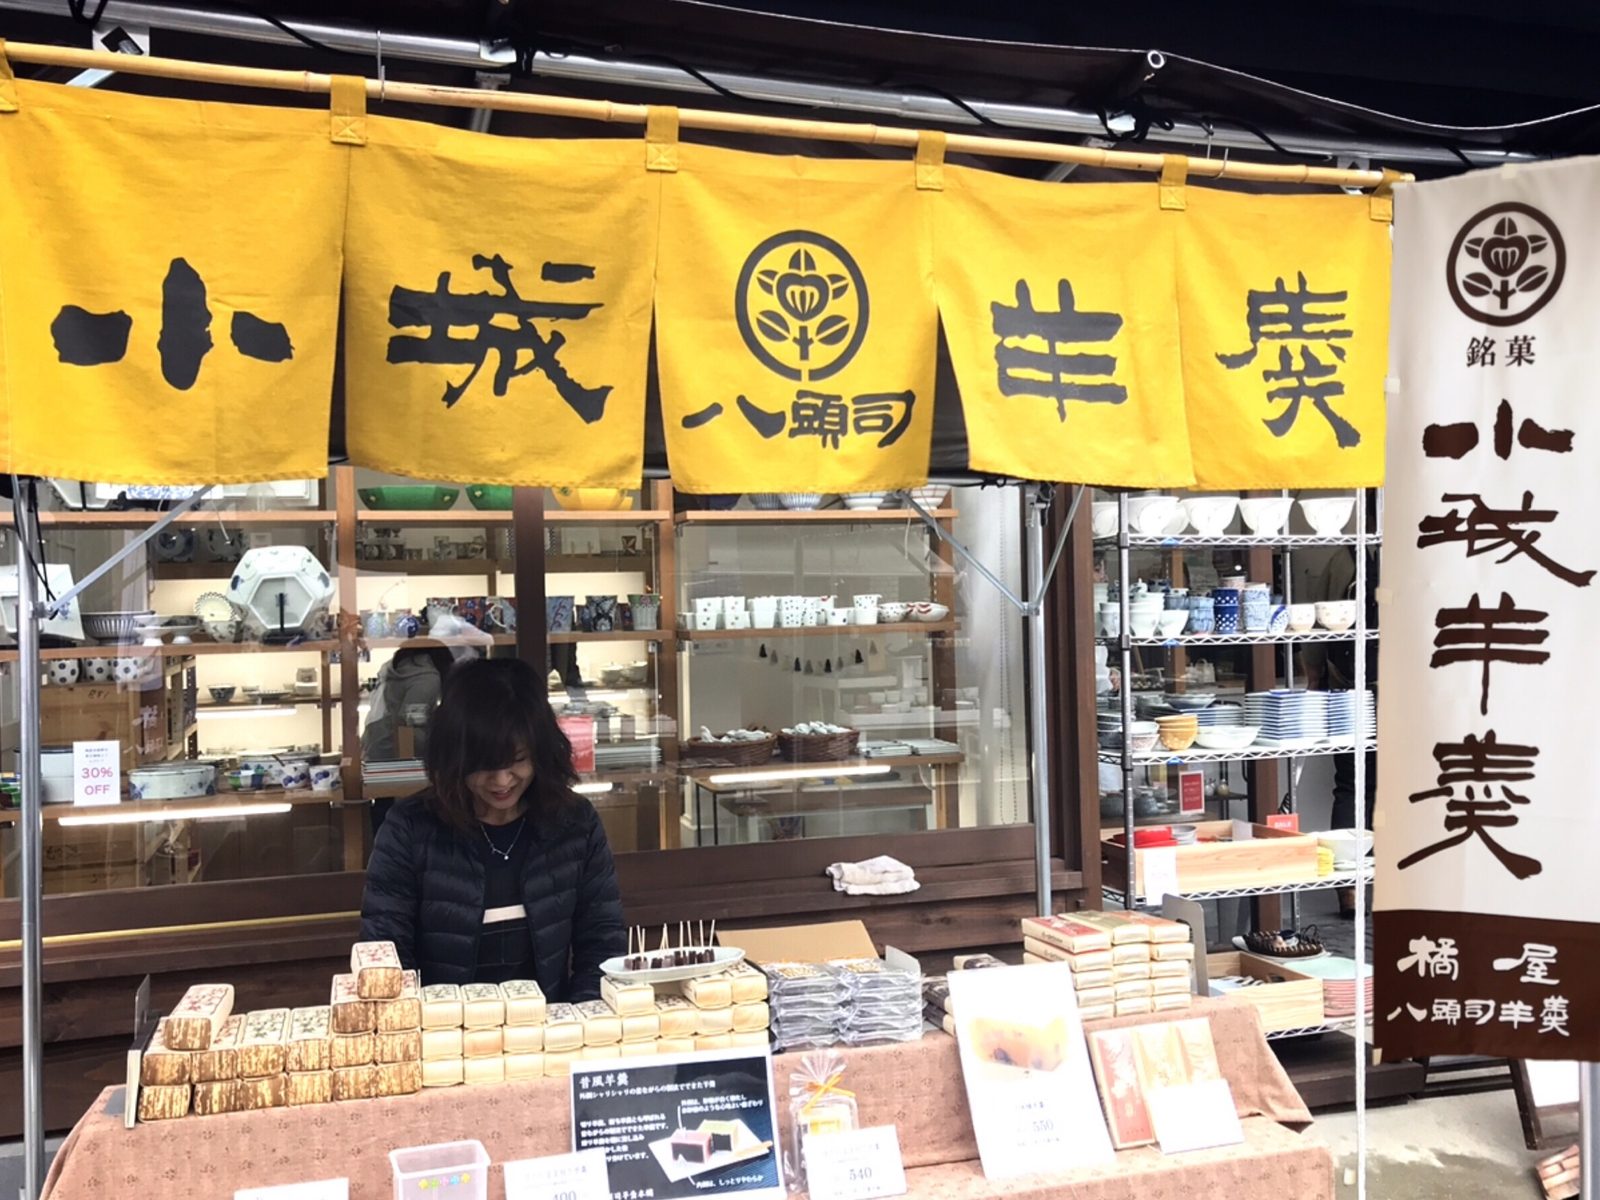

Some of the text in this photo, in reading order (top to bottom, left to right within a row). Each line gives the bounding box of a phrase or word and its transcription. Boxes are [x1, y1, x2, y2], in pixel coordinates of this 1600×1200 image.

[1466, 335, 1536, 367] 銘菓
[682, 390, 916, 448] 八頭司
[81, 767, 113, 779] 30%
[84, 784, 111, 796] OFF
[1387, 995, 1570, 1036] 八頭司羊羹
[849, 1167, 872, 1181] 540
